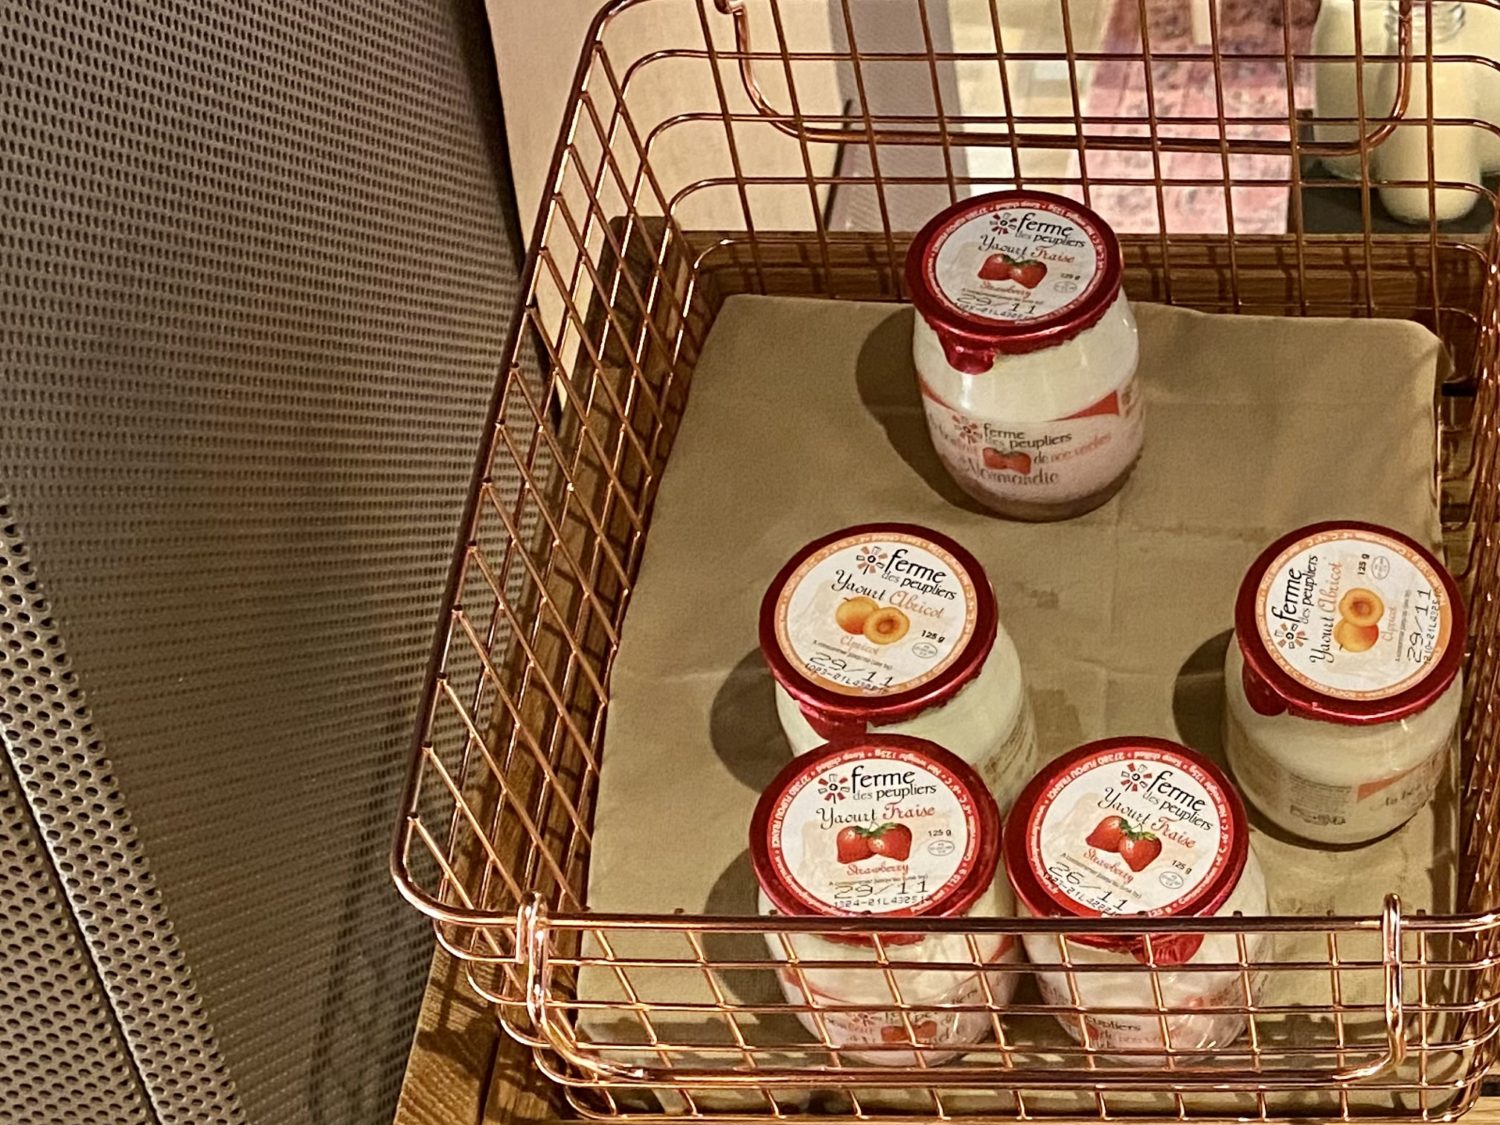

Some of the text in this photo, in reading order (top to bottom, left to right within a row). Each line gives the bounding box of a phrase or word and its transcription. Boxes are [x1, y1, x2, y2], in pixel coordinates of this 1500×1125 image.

[1017, 213, 1073, 237] ferme
[978, 234, 1075, 263] Yaourt Fraise
[1033, 234, 1085, 248] peupliers
[983, 423, 1025, 439] ferme
[1009, 432, 1072, 449] peupliers
[884, 549, 946, 583] ferme
[1302, 555, 1319, 606] peupliers
[831, 569, 945, 619] Yaourt Abricot
[881, 572, 957, 600] des peupliers
[1272, 567, 1303, 622] ferme
[1309, 617, 1335, 664] Yaourt
[851, 765, 916, 794] ferme
[853, 783, 937, 801] des peupliers
[1149, 770, 1206, 812] ferme
[816, 801, 936, 830] Yaourt Fraise
[1097, 786, 1196, 848] Yaourt Fraise
[1158, 798, 1214, 831] peupliers
[847, 861, 910, 877] Strawberry
